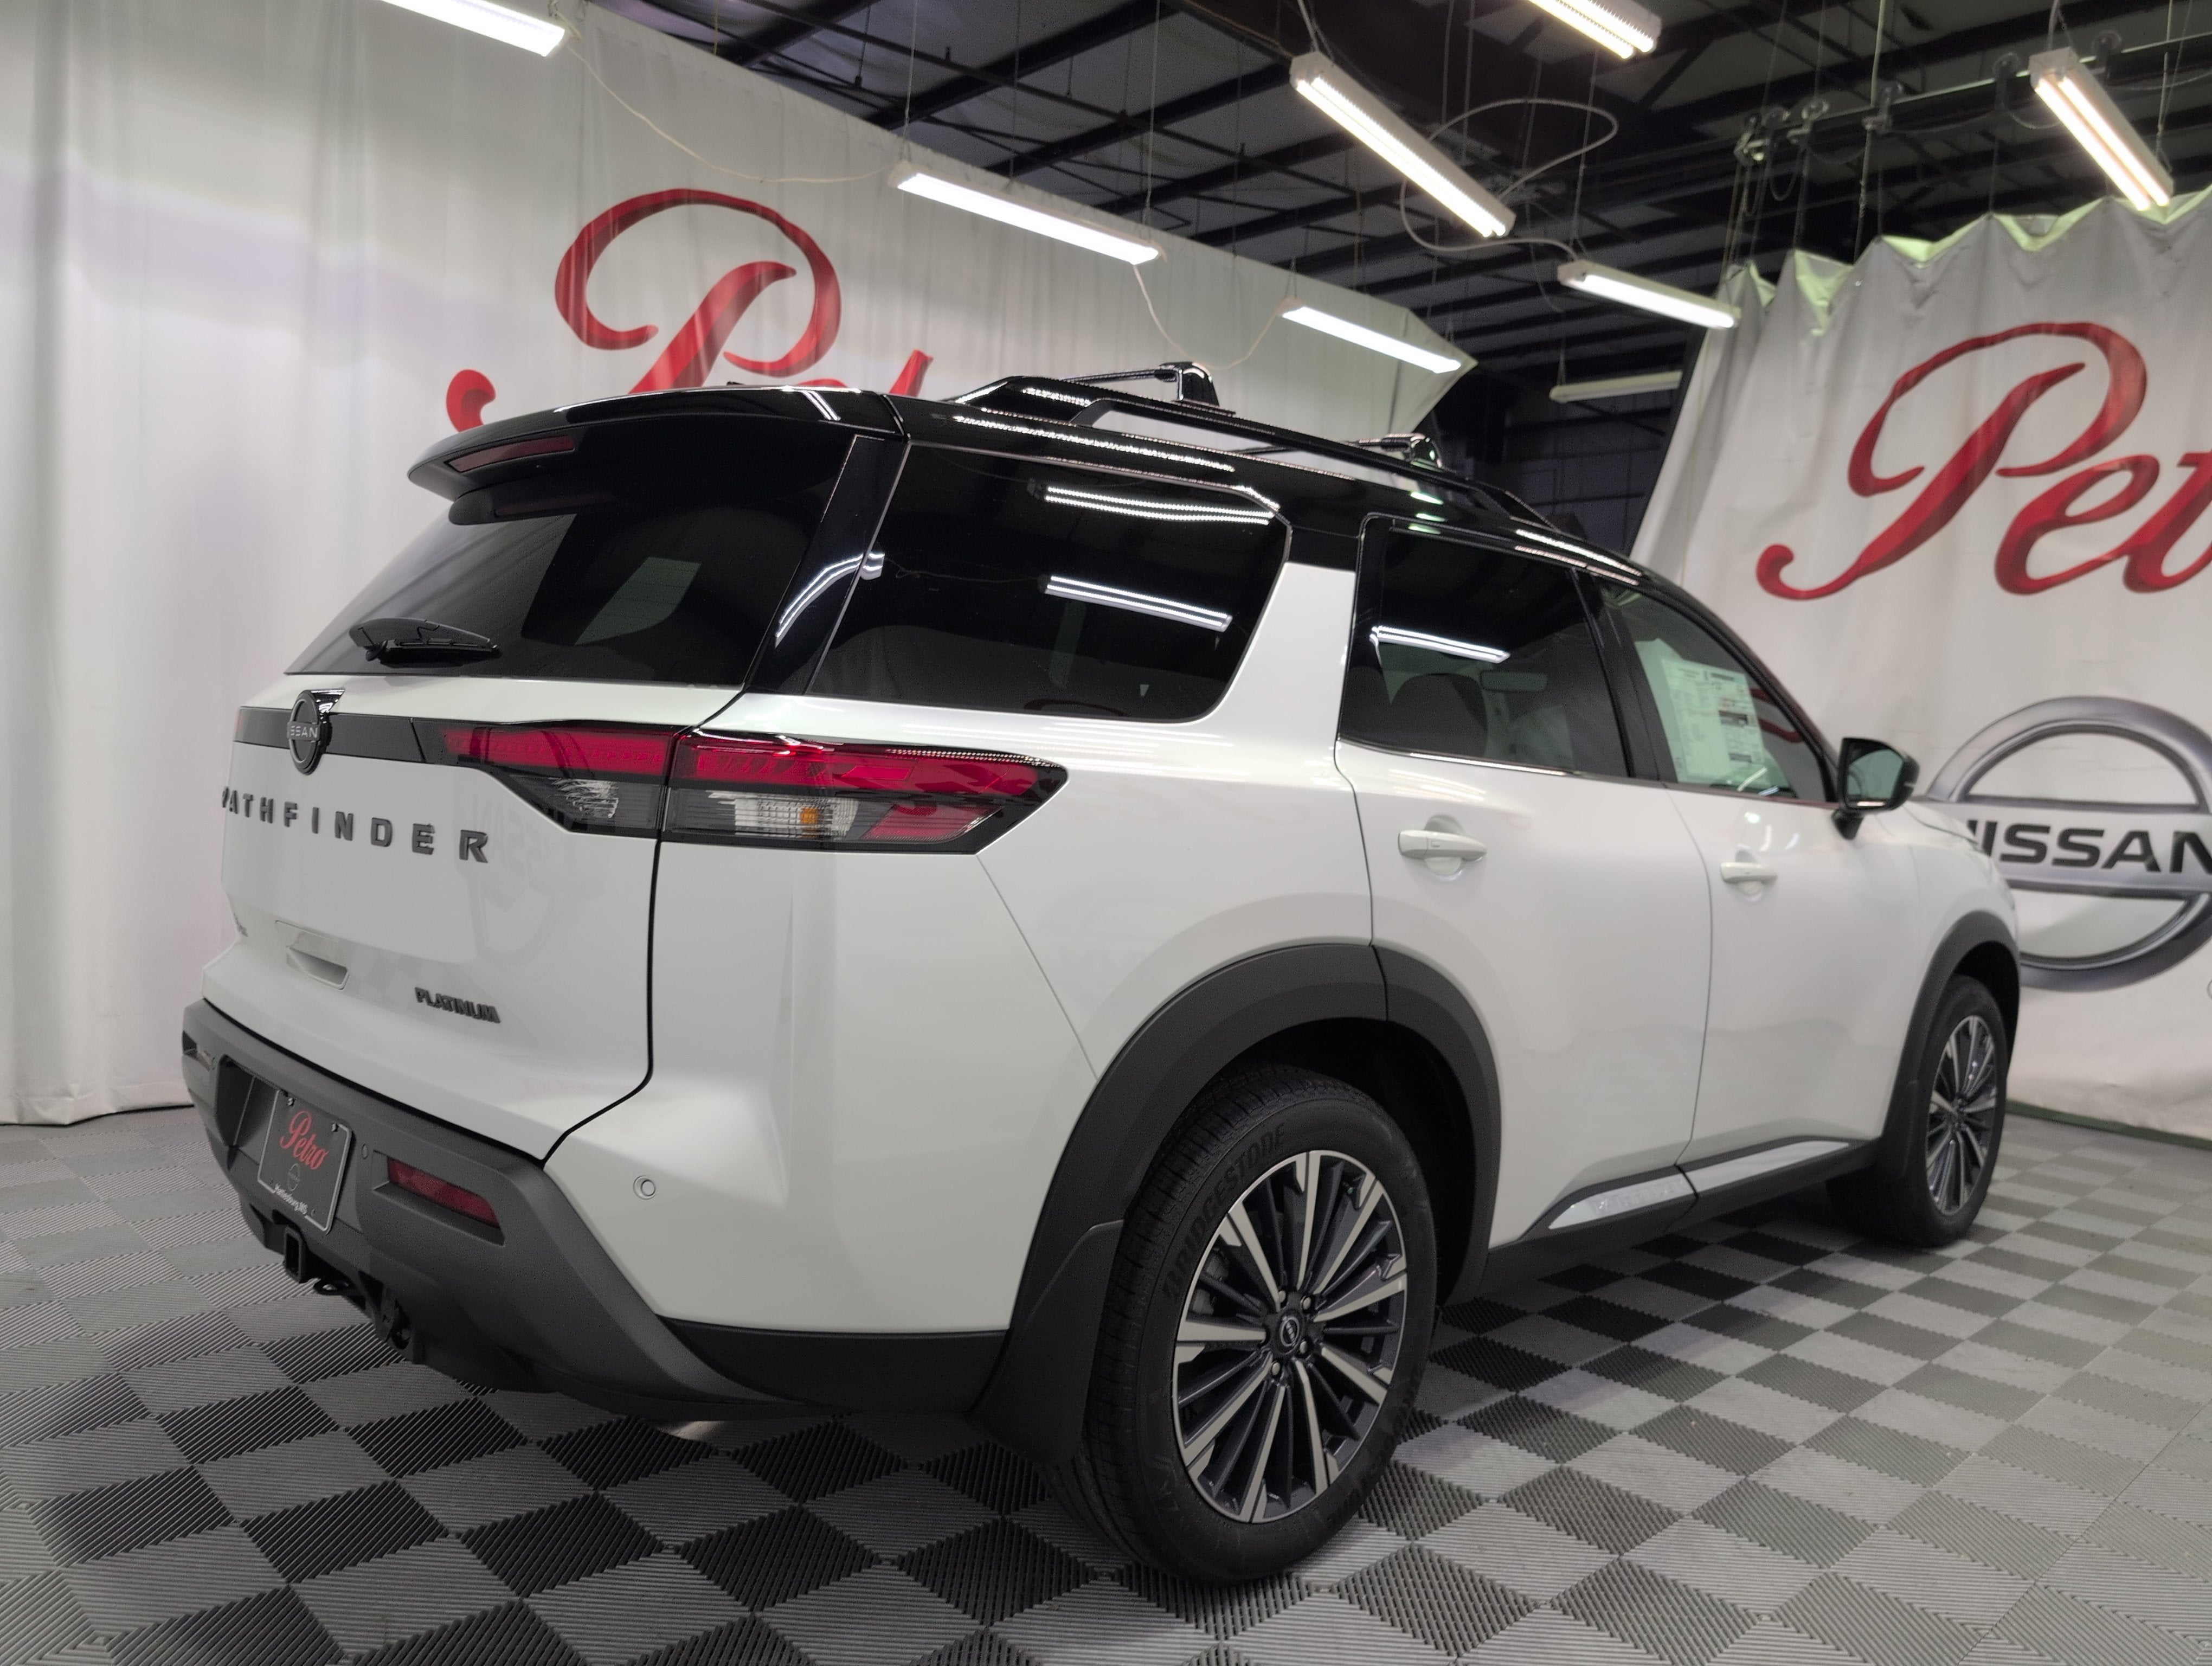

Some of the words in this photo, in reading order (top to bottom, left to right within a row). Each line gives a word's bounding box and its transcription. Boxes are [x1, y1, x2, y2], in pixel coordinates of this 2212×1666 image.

[221, 785, 488, 864] PATHFINDER
[1966, 819, 2212, 875] ISSAN
[414, 986, 501, 1024] PLATINUM
[279, 1110, 329, 1170] Petro
[1162, 1123, 1285, 1300] BRIDGESTONE
